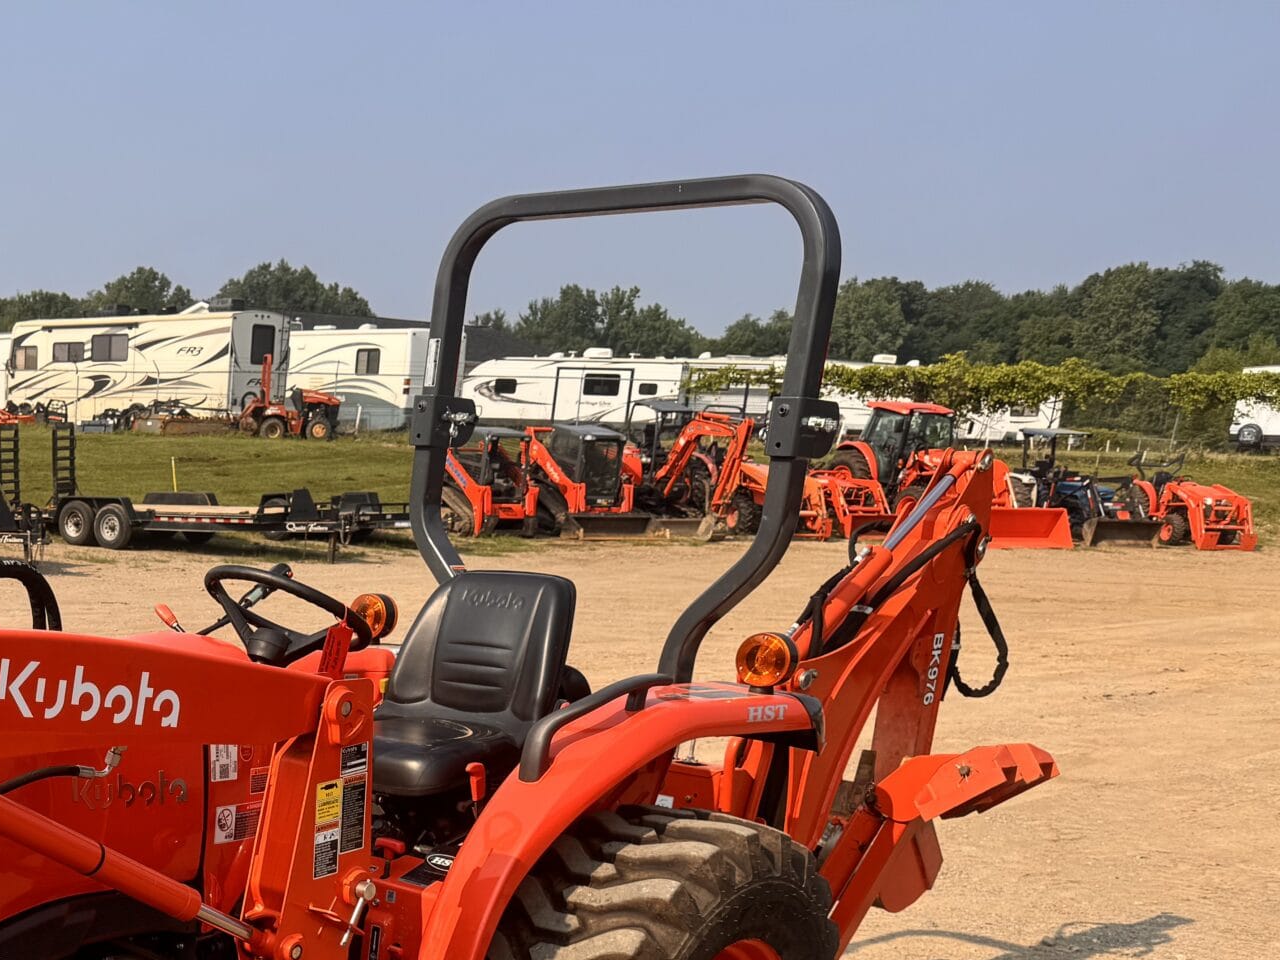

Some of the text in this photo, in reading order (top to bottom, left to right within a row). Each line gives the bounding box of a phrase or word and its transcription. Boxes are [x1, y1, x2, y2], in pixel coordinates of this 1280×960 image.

[176, 346, 204, 356] FR3
[246, 378, 262, 386] FR
[461, 588, 523, 609] Kubota
[923, 633, 945, 706] BK976
[746, 703, 789, 723] HST
[71, 769, 189, 810] Kubota
[430, 856, 453, 867] HS
